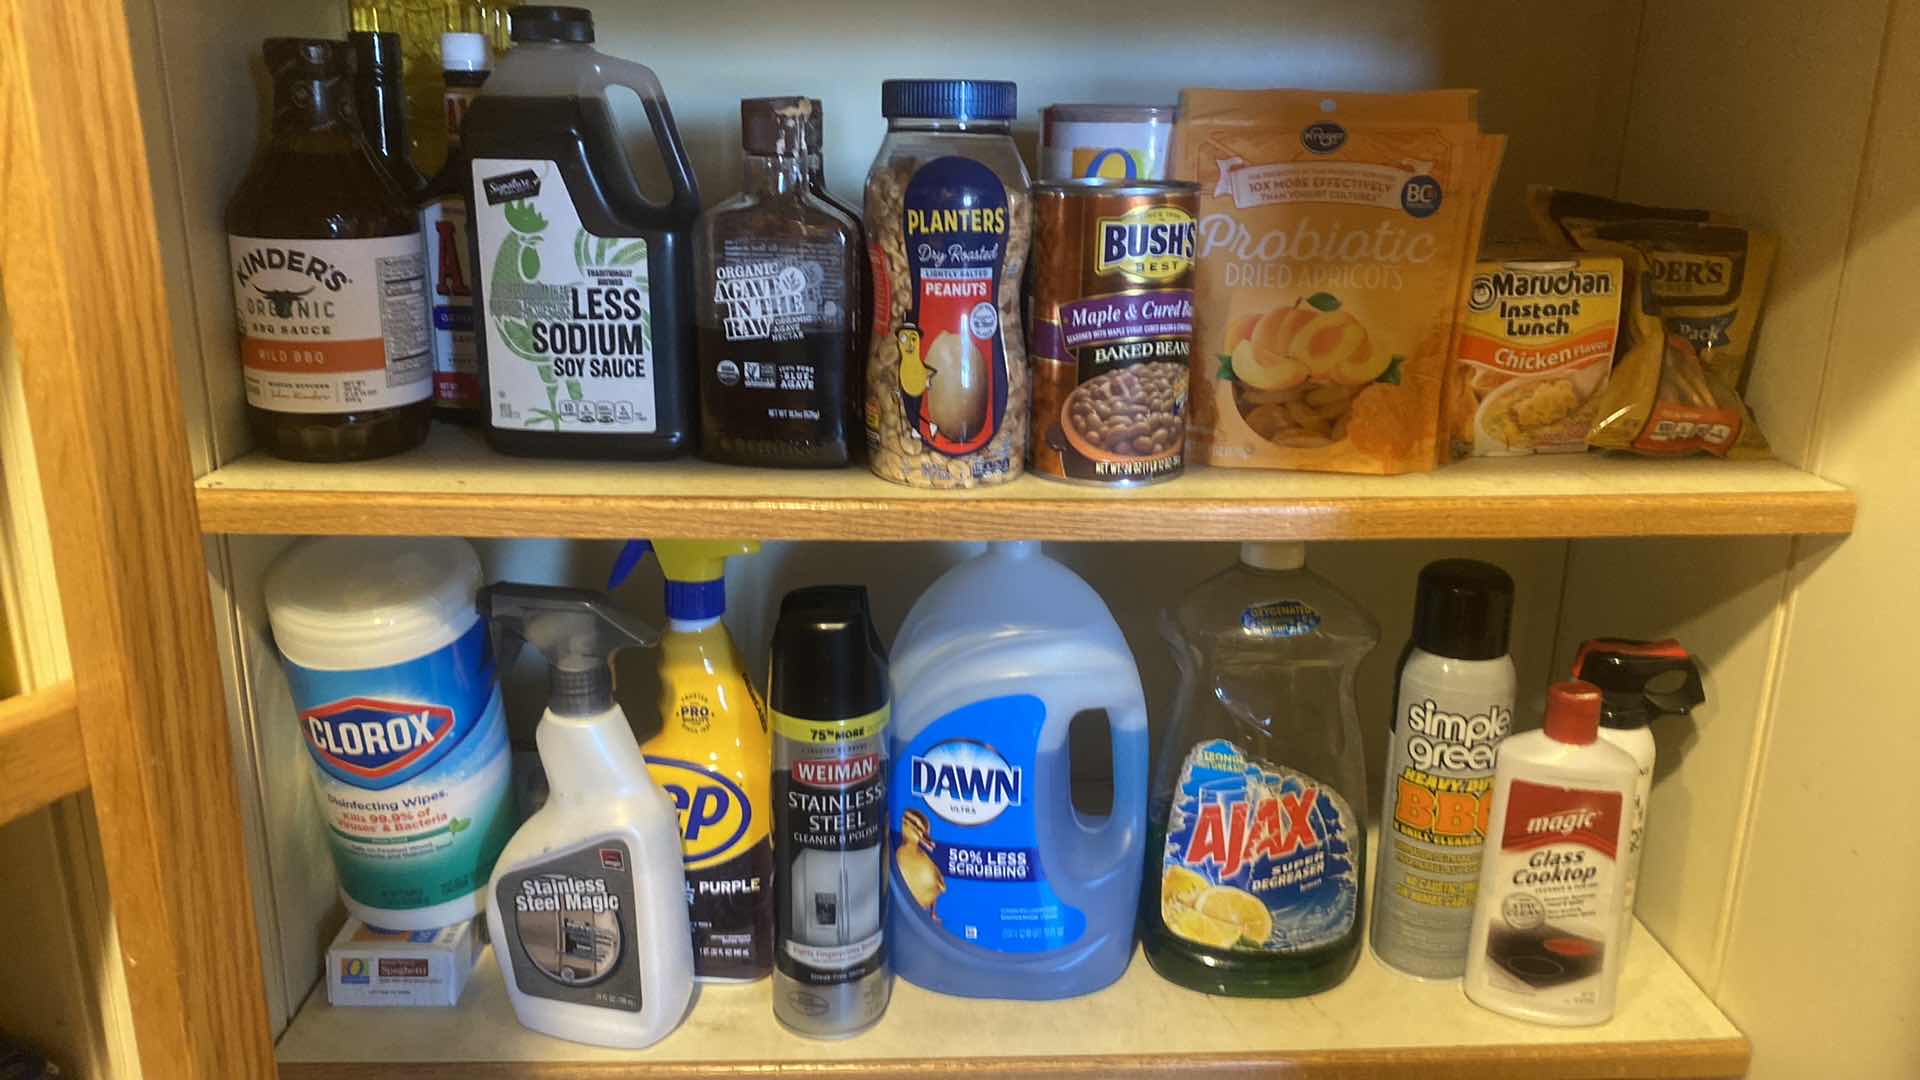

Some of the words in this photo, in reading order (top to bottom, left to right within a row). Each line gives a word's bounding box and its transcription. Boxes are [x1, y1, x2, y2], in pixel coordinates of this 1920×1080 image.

[1311, 176, 1393, 194] EFFECTIVELY
[1407, 184, 1434, 203] BC
[907, 207, 1006, 234] PLANTERS
[1104, 223, 1196, 263] BUSH'S
[1200, 213, 1437, 264] Probiotic
[918, 243, 947, 267] Dry
[949, 242, 999, 264] Roasted
[235, 247, 349, 292] KINDER'S
[716, 262, 779, 280] ORGANIC
[1136, 261, 1178, 273] BEST
[1225, 263, 1292, 289] DRIED
[1298, 263, 1403, 290] APRICOTS
[1653, 258, 1724, 286] DER'S
[925, 282, 988, 296] PEANUTS
[1493, 271, 1612, 298] Maruchan
[248, 301, 336, 319] ORGNIC
[571, 288, 642, 321] LESS
[1072, 305, 1122, 327] Maple
[1125, 307, 1139, 321] &
[1142, 300, 1180, 319] Cured
[1500, 301, 1580, 319] Instant
[280, 326, 331, 335] SAUCE
[532, 322, 644, 355] SODIUM
[723, 317, 771, 341] RAW
[1507, 320, 1569, 336] Lunch
[293, 352, 325, 364] BBQ
[1095, 342, 1153, 363] BAKED
[1495, 348, 1573, 369] Chicken
[554, 358, 586, 377] SOY
[590, 359, 645, 377] SAUCE
[780, 380, 815, 391] AGAVE
[1095, 461, 1109, 475] NET
[680, 706, 709, 719] PRO
[1409, 700, 1511, 744] simple
[309, 710, 434, 757] CLOROX
[835, 727, 864, 740] MORE
[798, 757, 873, 782] WEIMAN
[1404, 766, 1461, 792] HEAVY
[912, 757, 1022, 806] DAWN
[327, 793, 399, 811] Disinfecting
[788, 782, 885, 812] STAINLESS
[394, 812, 448, 832] Bacteria
[662, 784, 731, 841] ep
[809, 811, 867, 832] STEEL
[1527, 808, 1597, 834] magic
[793, 831, 836, 845] CLEANER
[1186, 786, 1318, 879] AJAX
[949, 847, 983, 866] 50%
[987, 851, 1027, 866] LESS
[1271, 850, 1325, 876] SUPER
[1529, 850, 1585, 868] Glass
[948, 861, 1026, 879] SCRUBBING
[1512, 865, 1598, 886] Cooktop
[522, 877, 606, 896] Stainless
[699, 877, 760, 895] PURPLE
[516, 896, 561, 913] Steel
[565, 894, 620, 913] Magic
